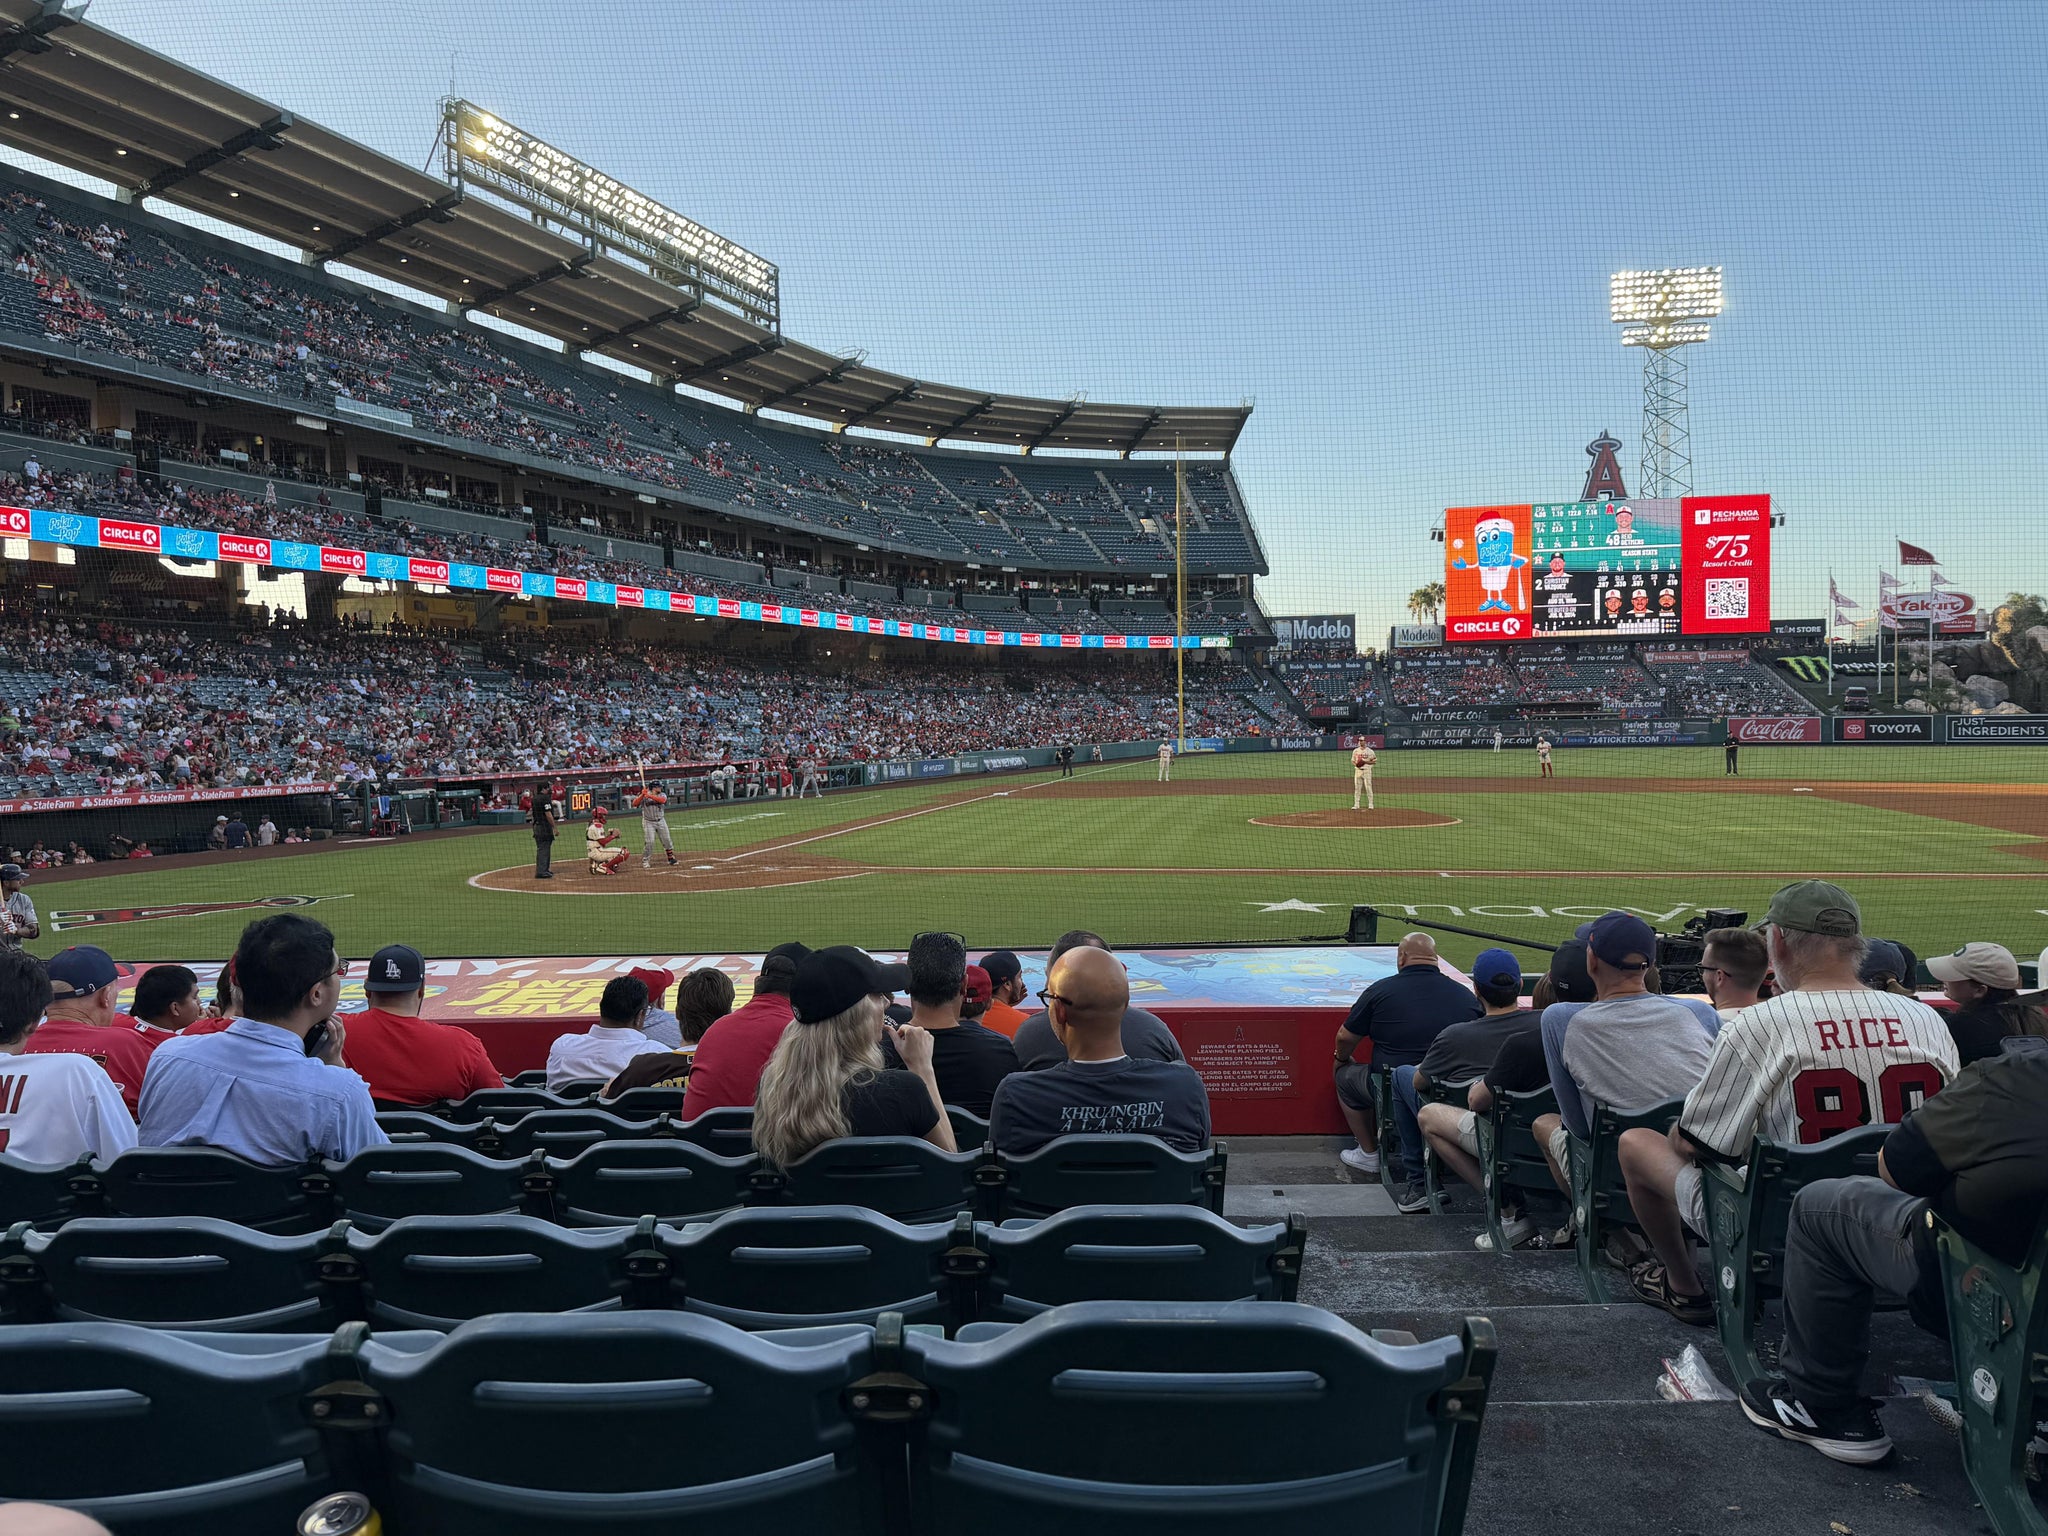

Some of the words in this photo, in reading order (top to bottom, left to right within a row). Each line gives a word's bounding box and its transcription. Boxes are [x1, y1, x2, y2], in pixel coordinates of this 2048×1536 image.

[50, 516, 73, 530] Polar
[60, 528, 77, 542] Pop
[103, 527, 140, 540] CIRCLE
[1606, 534, 1620, 545] 48
[222, 542, 254, 553] CIRCLE
[1706, 534, 1750, 558] $75
[324, 553, 351, 564] CIRCLE
[411, 564, 436, 575] CIRCLE
[489, 574, 510, 584] CIRCLE
[1535, 579, 1542, 590] 2
[557, 583, 576, 592] CIRCLE
[1293, 619, 1351, 640] Modelo
[1454, 622, 1500, 633] CIRCLE
[1401, 629, 1437, 641] Modelo
[1957, 718, 1985, 726] JUST
[1739, 720, 1807, 740] Coca-Cola
[1870, 724, 1922, 734] TOYOTA
[1958, 726, 2045, 736] INGREDIENTS
[1282, 738, 1311, 748] Modelo
[572, 793, 591, 810] 009
[1815, 1018, 1909, 1051] RICE
[1792, 1062, 1950, 1144] 80
[1060, 1100, 1164, 1120] KHRUANGBIN
